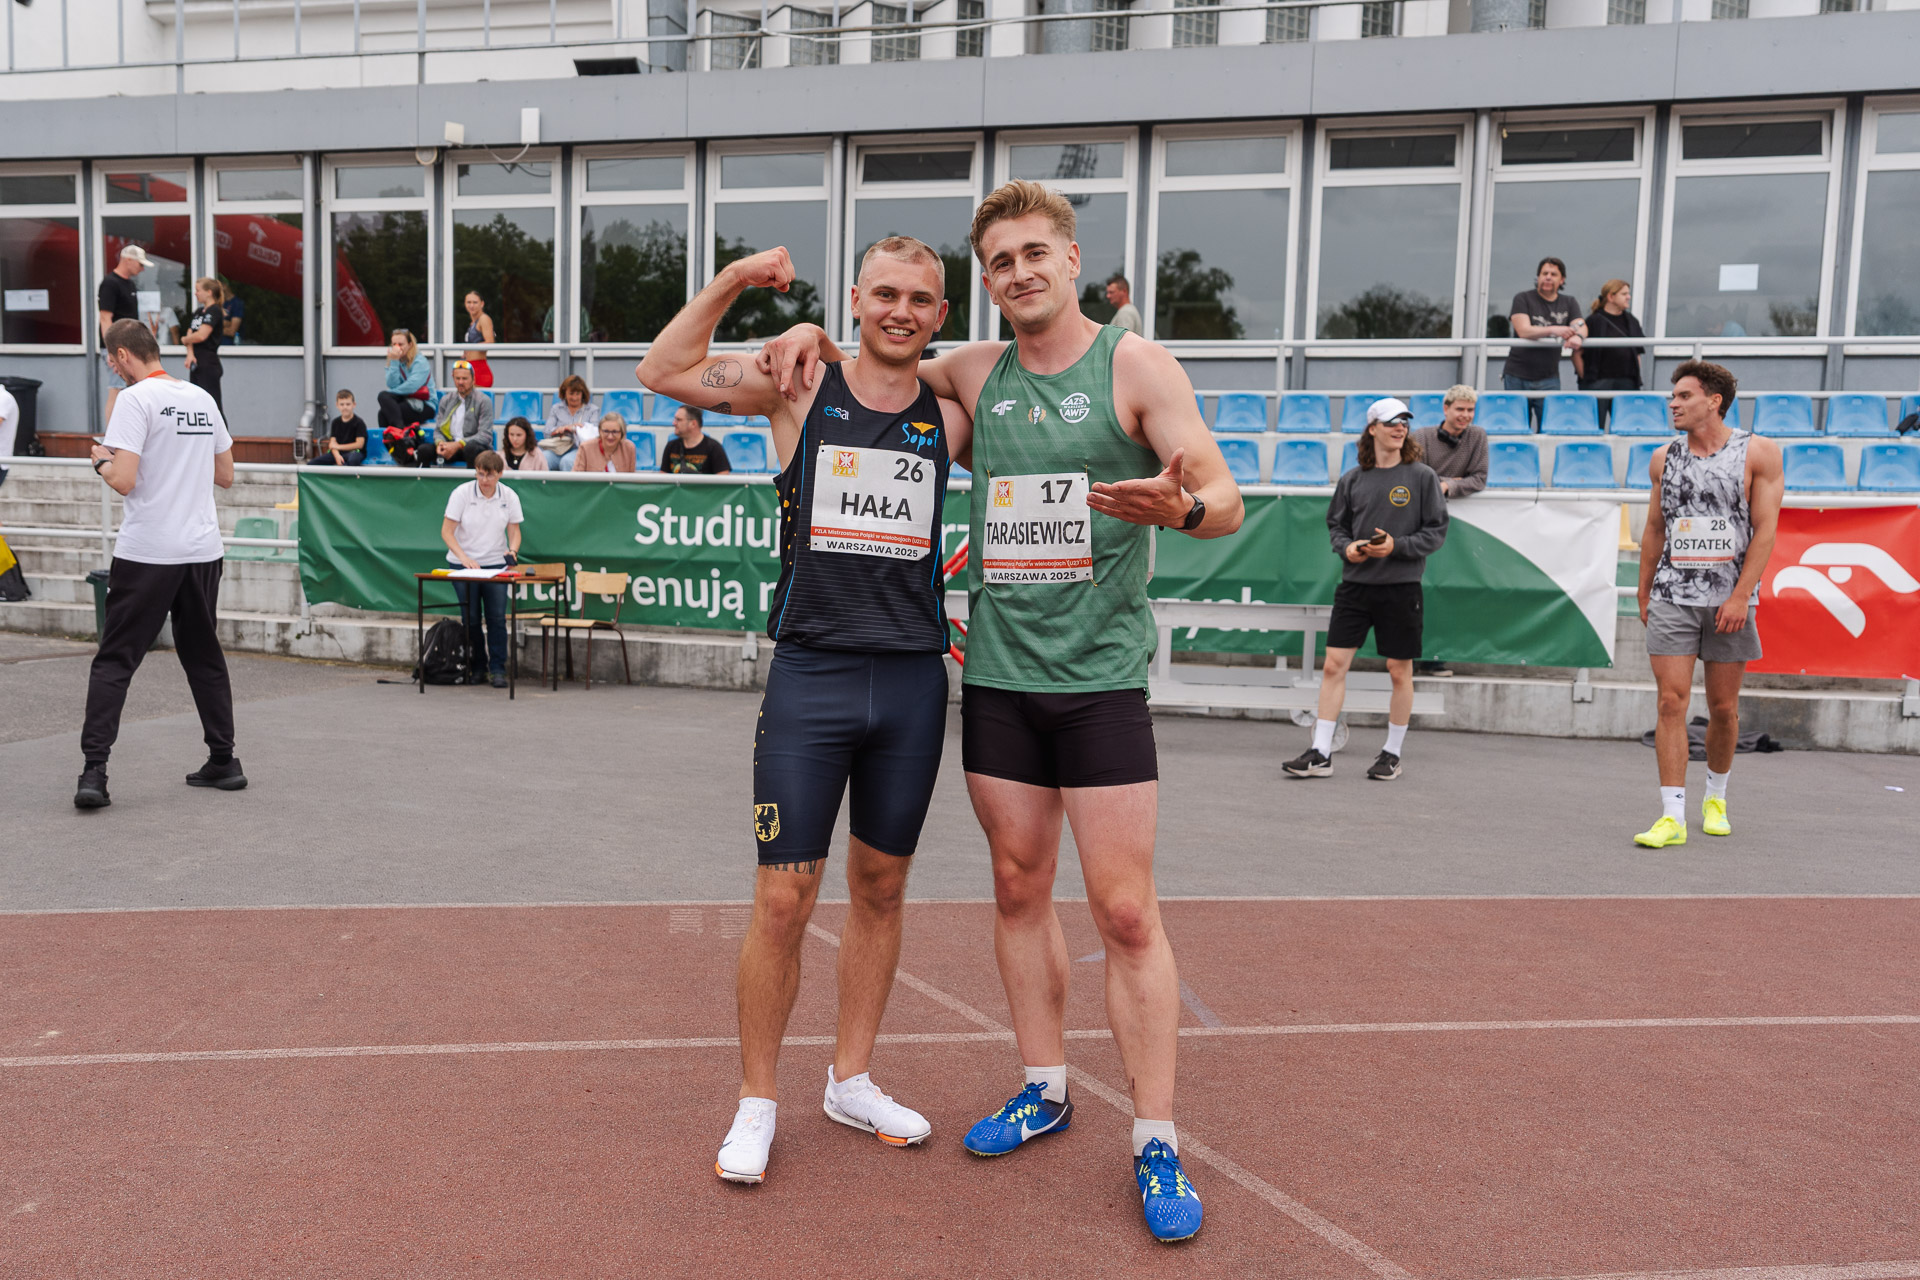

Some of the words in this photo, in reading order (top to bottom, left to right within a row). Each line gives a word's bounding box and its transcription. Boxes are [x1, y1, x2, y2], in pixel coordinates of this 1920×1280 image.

[991, 399, 1017, 416] 4F
[1067, 397, 1084, 405] AZS
[177, 411, 213, 426] FUEL
[1064, 409, 1085, 417] AWF
[901, 423, 940, 452] Sopot
[834, 467, 856, 477] PZLA
[893, 457, 924, 483] 26
[1040, 480, 1073, 504] 17
[840, 492, 912, 522] HAŁA
[986, 520, 1086, 545] TARASIEWICZ
[1710, 519, 1727, 531] 28
[826, 541, 892, 555] WARSZAWA
[894, 547, 918, 558] 2025
[1674, 538, 1732, 550] OSTATEK
[990, 572, 1048, 581] WARSZAWA
[1050, 571, 1077, 580] 2025
